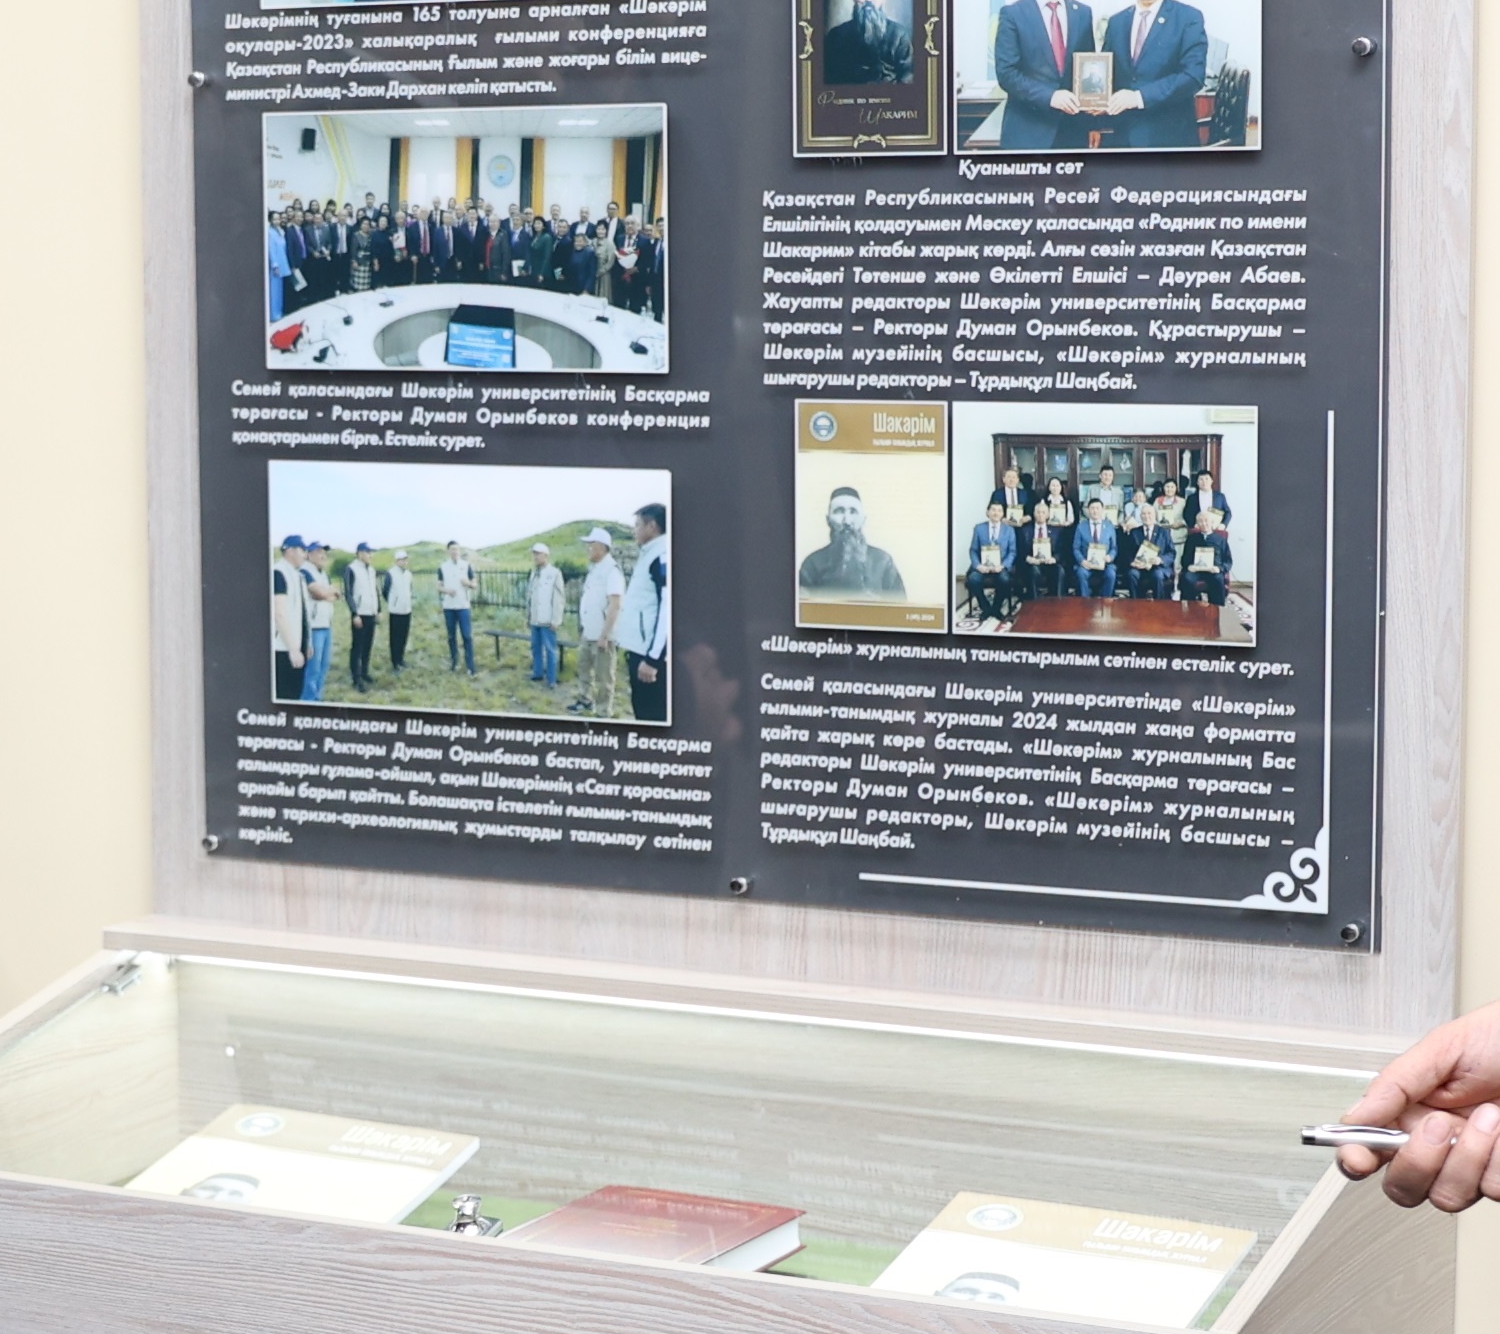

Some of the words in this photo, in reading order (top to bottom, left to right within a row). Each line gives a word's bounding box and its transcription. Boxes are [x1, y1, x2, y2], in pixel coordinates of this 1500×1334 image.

[958, 158, 1052, 182] Қуанышты
[1055, 160, 1085, 175] сәт
[762, 213, 852, 235] Елшілігінің
[853, 218, 962, 237] қолдауымен
[964, 213, 1034, 236] Мәскеу
[1035, 217, 1135, 234] қаласында
[1138, 212, 1217, 234] «Родник
[1219, 215, 1244, 230] по
[1247, 215, 1307, 230] имени
[762, 240, 855, 263] Шакарим»
[858, 239, 917, 259] кітабы
[919, 244, 980, 263] жарық
[982, 239, 1037, 263] көрді.
[1040, 239, 1086, 258] Алғы
[1090, 239, 1136, 258] сөзін
[1138, 242, 1206, 258] жазған
[1210, 238, 1307, 260] Қазақстан
[762, 291, 844, 314] Жауапты
[851, 296, 951, 315] редакторы
[959, 291, 1041, 315] Шәкәрім
[1049, 291, 1202, 316] университетінің
[1210, 292, 1307, 316] Басқарма
[763, 342, 844, 366] Шәкәрім
[851, 342, 943, 367] музейінің
[951, 343, 1045, 366] басшысы,
[1056, 344, 1165, 369] «Шәкәрім»
[1174, 350, 1307, 370] журналының
[231, 378, 282, 398] Семей
[287, 383, 394, 401] қаласындағы
[400, 381, 474, 404] Шәкәрім
[624, 384, 710, 408] Басқарма
[760, 634, 853, 660] «Шәкәрім»
[855, 642, 968, 664] журналының
[969, 648, 1100, 670] таныстырылым
[1103, 650, 1168, 671] сәтінен
[1171, 654, 1236, 674] естелік
[1238, 660, 1295, 680] сурет.
[922, 710, 1004, 730] журналы
[1011, 710, 1058, 731] 2024
[1065, 718, 1137, 737] жылдан
[1144, 722, 1195, 741] жаңа
[1203, 720, 1296, 746] форматта
[760, 723, 810, 743] қайта
[816, 729, 876, 750] жарық
[882, 733, 926, 753] көре
[934, 730, 1013, 756] бастады.
[1022, 737, 1123, 764] «Шәкәрім»
[1131, 747, 1253, 771] журналының
[1262, 750, 1297, 771] Бас
